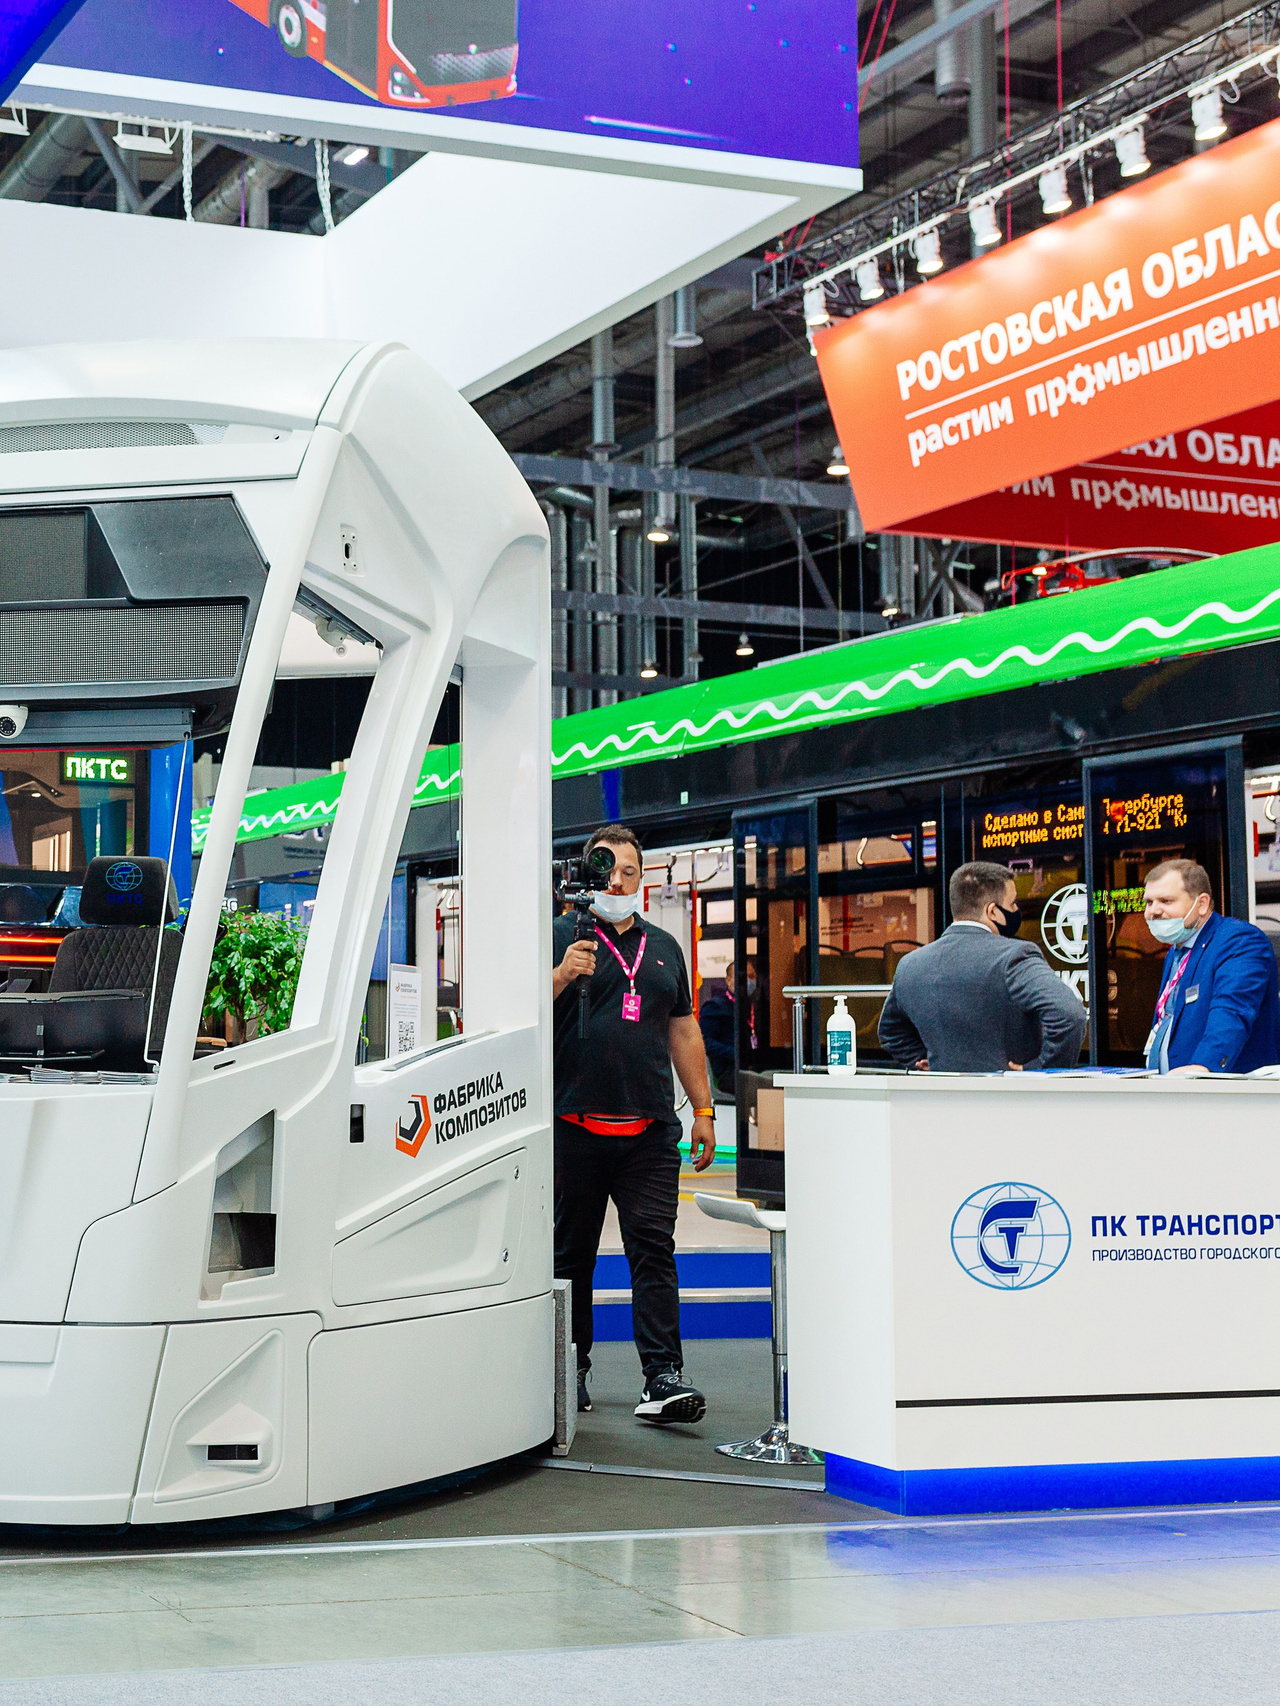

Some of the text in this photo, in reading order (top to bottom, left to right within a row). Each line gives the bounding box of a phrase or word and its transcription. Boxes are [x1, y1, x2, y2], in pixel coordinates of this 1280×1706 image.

[896, 267, 1134, 401] РОСТОВСКАЯ
[908, 296, 1280, 468] растим промышленн
[1070, 477, 1280, 519] промышлен
[65, 756, 128, 781] ПКТС
[984, 813, 1038, 832] Сделано
[1043, 809, 1052, 824] в
[106, 893, 144, 905] ПКТС
[433, 1071, 504, 1115] ФАБРИКА
[435, 1088, 527, 1145] КОМПОЗИТОВ
[1091, 1215, 1128, 1237] ПК
[1092, 1247, 1197, 1261] ПРОИЗВОДСТВО
